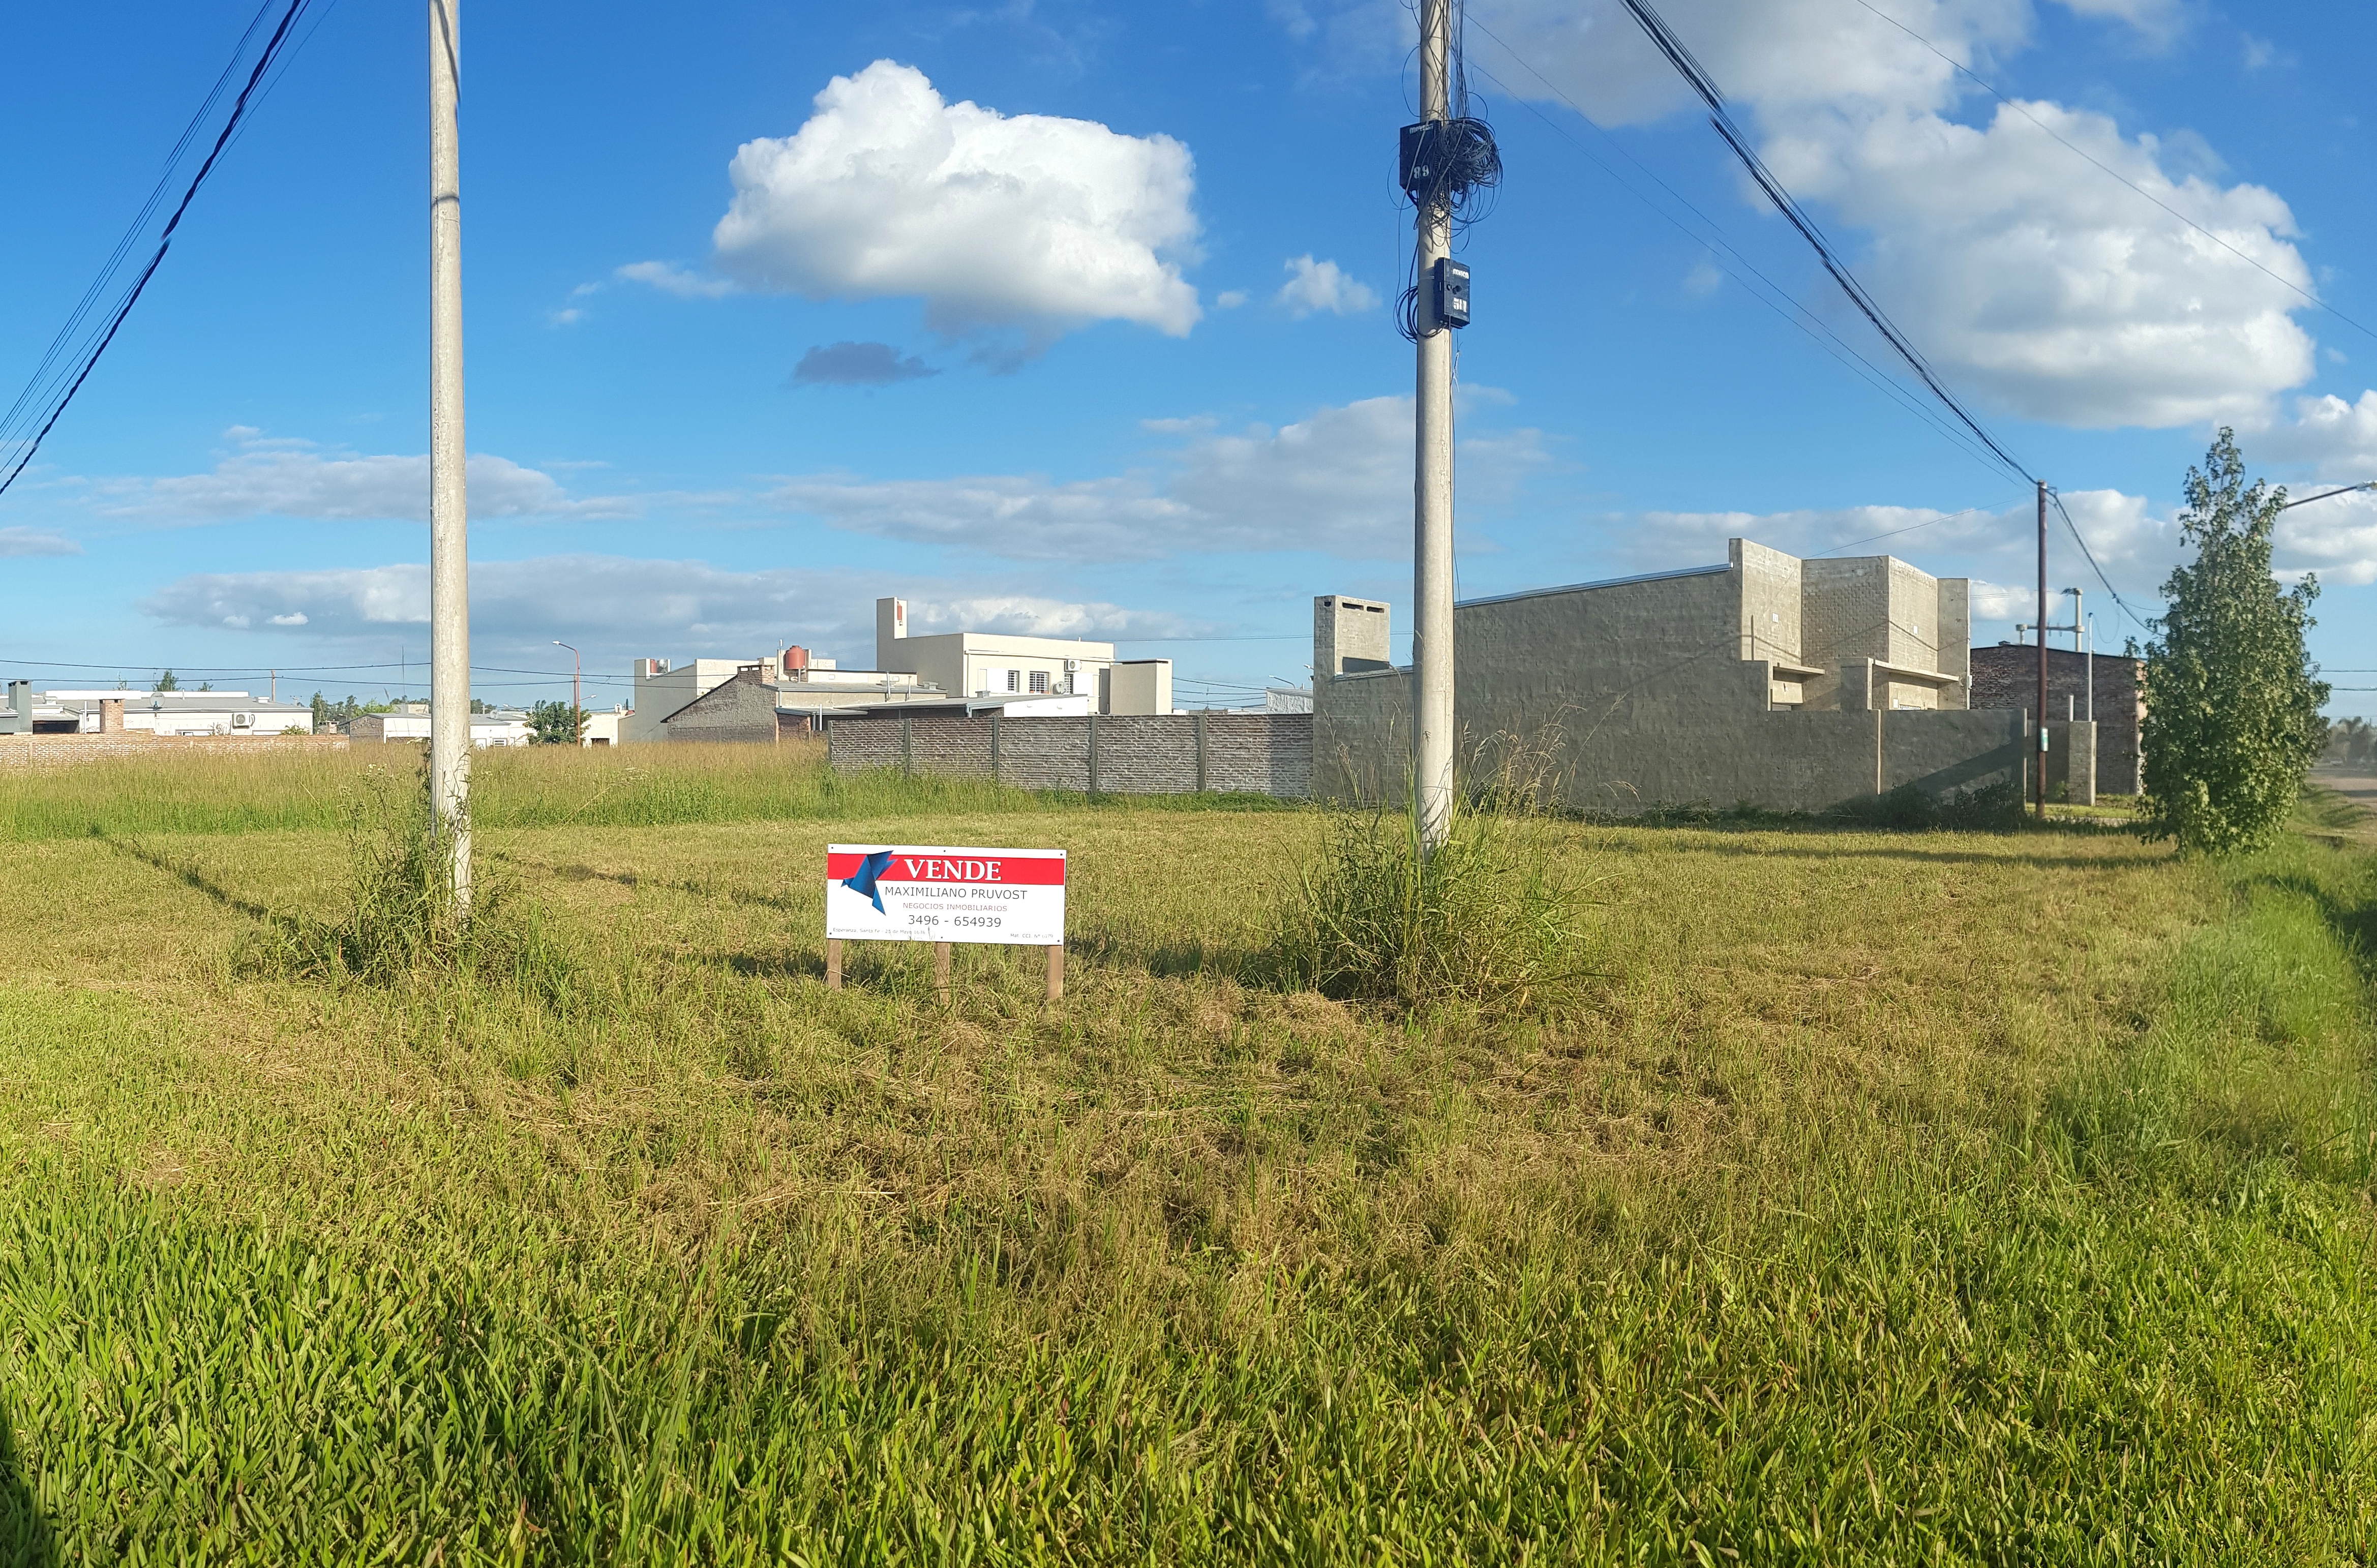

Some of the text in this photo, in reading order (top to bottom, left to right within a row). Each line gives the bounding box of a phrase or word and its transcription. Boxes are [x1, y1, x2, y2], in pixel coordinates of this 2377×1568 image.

[904, 858, 1001, 881] VENDE
[885, 886, 1028, 899] MAXIMILIANO PRUVOST
[946, 903, 1007, 912] INMOBILIARIOS
[908, 915, 939, 925] 3496
[954, 916, 1001, 927] 654939
